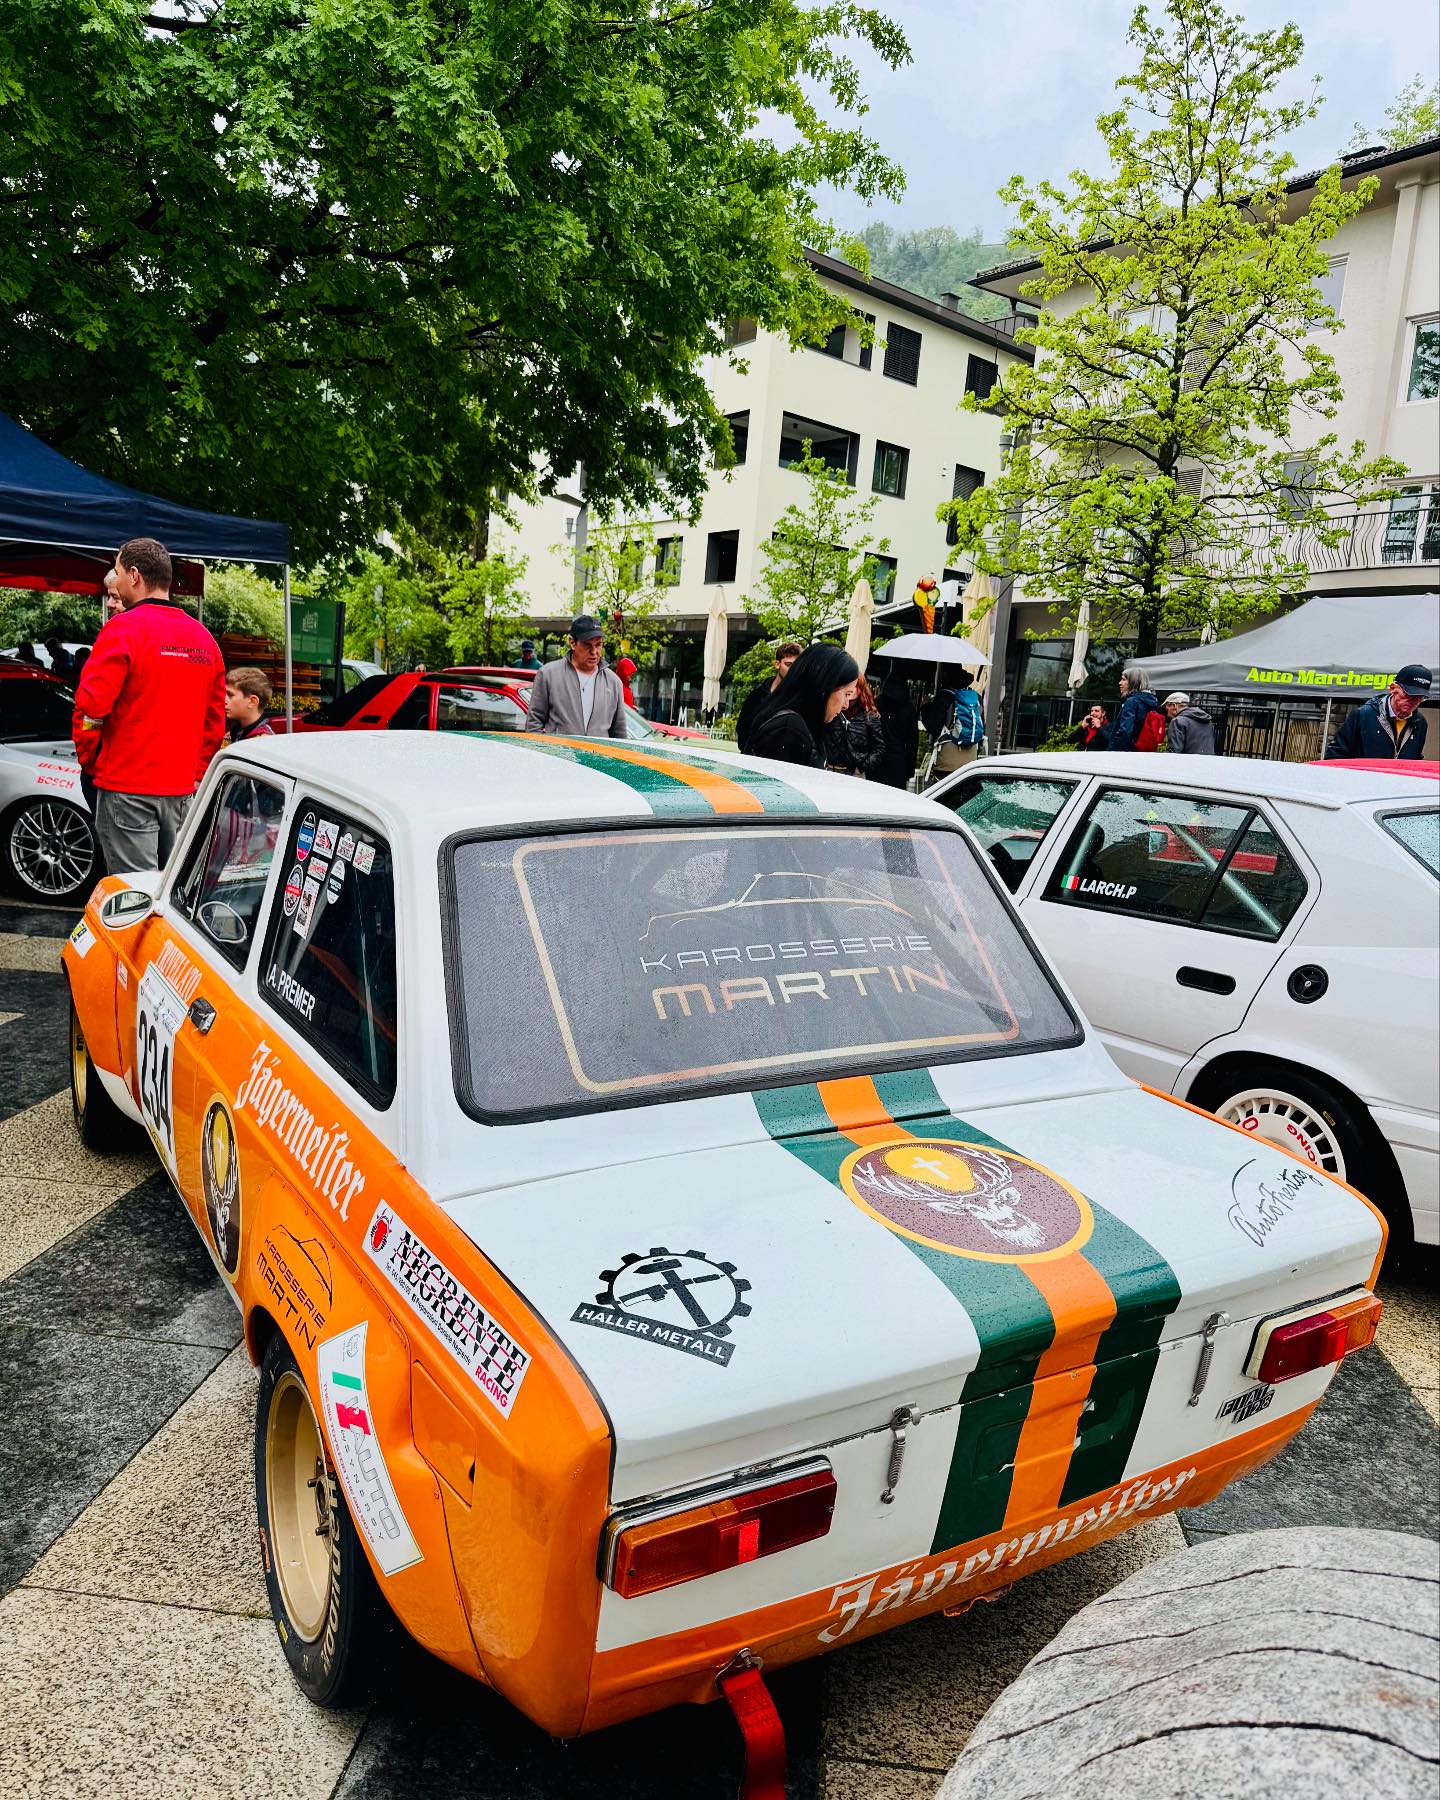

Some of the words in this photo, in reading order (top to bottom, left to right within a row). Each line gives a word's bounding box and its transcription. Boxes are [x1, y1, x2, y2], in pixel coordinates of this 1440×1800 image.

[1245, 667, 1293, 683] Auto
[37, 775, 74, 789] BOSCH
[1079, 878, 1138, 900] LARCH.P
[640, 935, 932, 974] KAROSSERIE
[268, 964, 277, 988] A.
[277, 970, 316, 1021] PREMER
[651, 963, 949, 1020] MARTIN
[139, 1009, 173, 1153] 234
[256, 1251, 317, 1351] MARTIN
[264, 1236, 326, 1329] KAROSSERIE
[389, 1230, 527, 1395] NEGRENTE
[579, 1308, 651, 1336] HALLER
[652, 1327, 725, 1360] METALL
[475, 1365, 508, 1408] RACING
